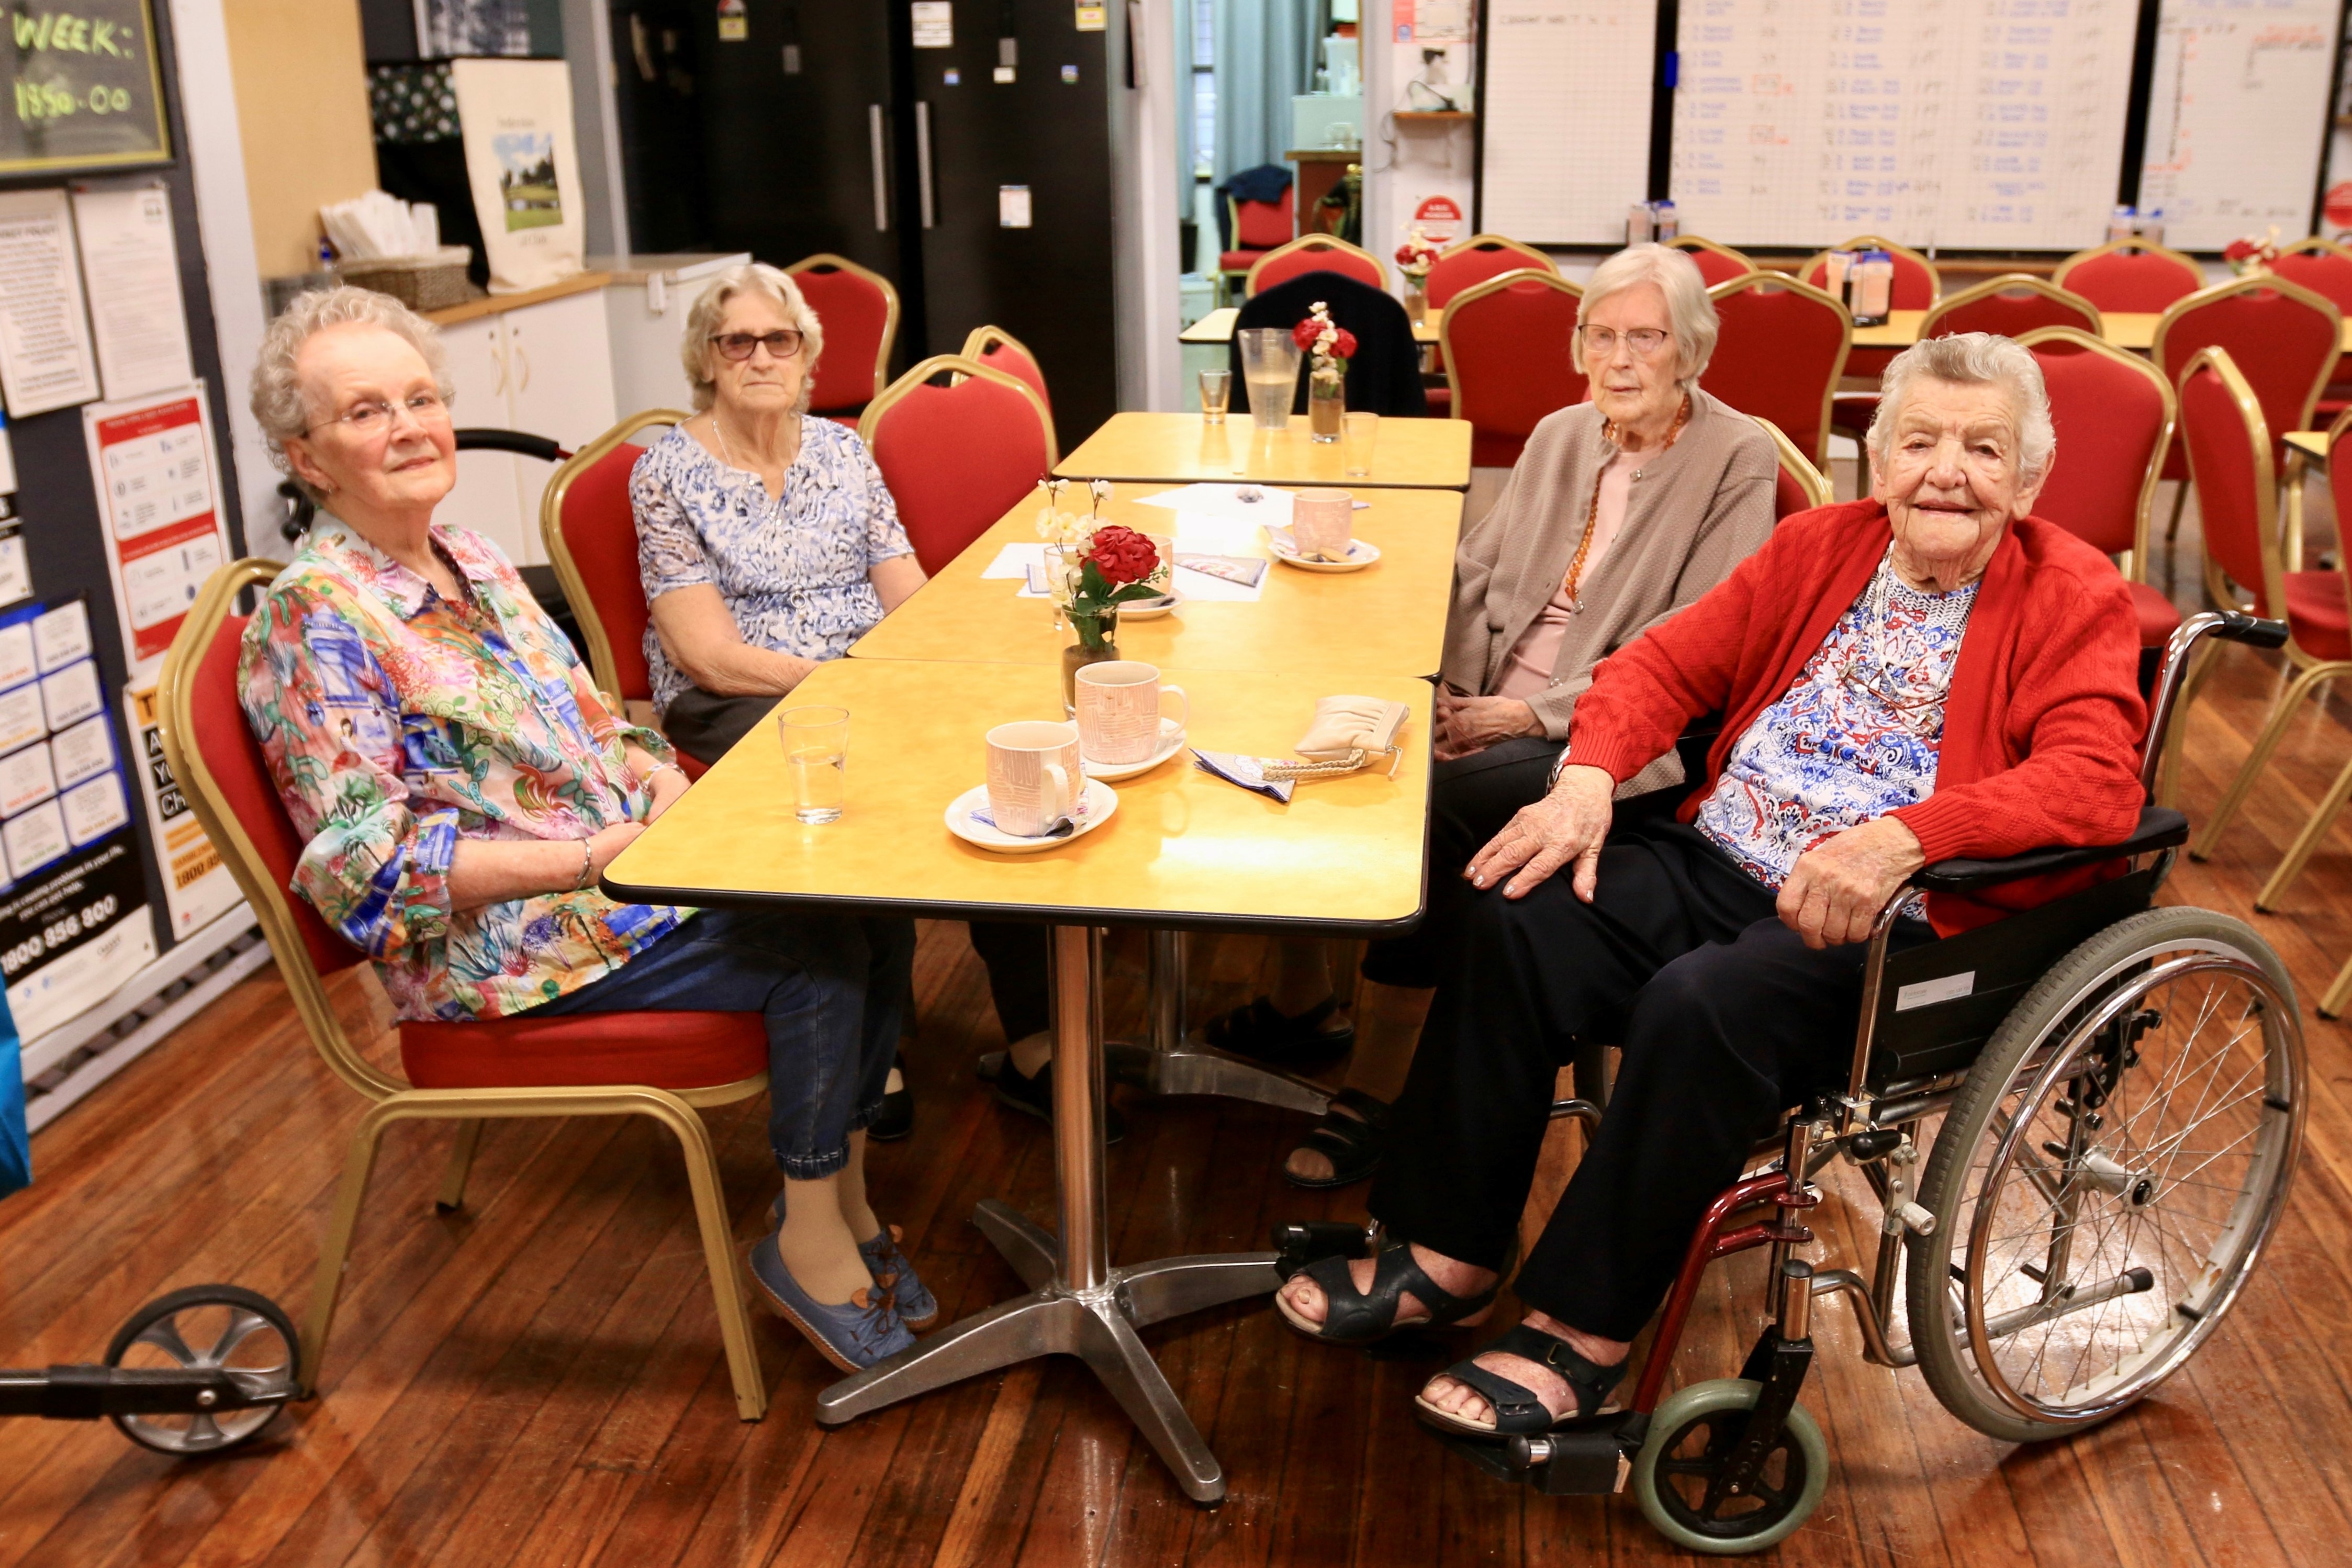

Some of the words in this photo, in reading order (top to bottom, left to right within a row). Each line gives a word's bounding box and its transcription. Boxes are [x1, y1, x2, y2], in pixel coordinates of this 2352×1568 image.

[13, 12, 135, 60] WEEK:
[50, 865, 84, 890] problems
[93, 852, 109, 867] your
[1, 934, 45, 975] 1800
[81, 893, 117, 928] 800
